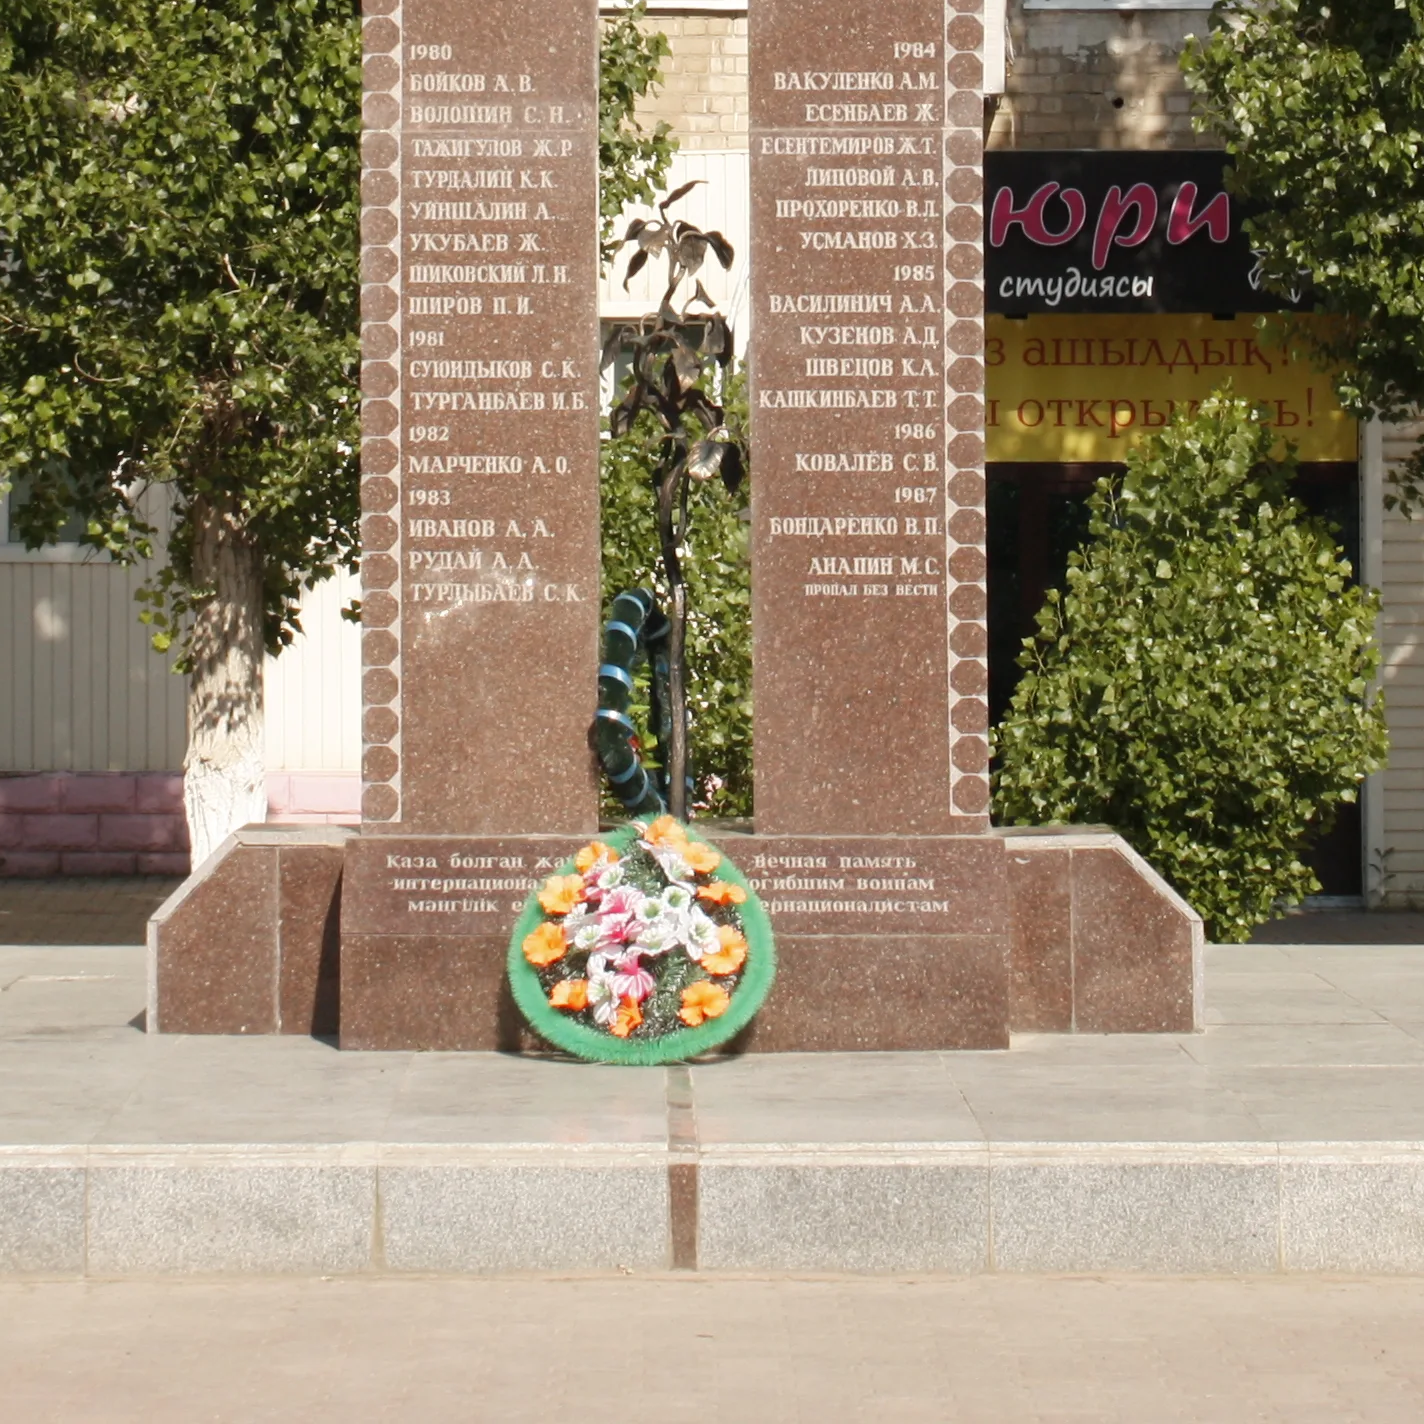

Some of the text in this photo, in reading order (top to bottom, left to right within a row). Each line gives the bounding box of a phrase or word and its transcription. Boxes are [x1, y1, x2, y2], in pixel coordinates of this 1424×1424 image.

[410, 45, 452, 60] 1980
[894, 42, 935, 58] 1984
[410, 72, 485, 92] БОЙКОВ
[774, 72, 894, 90] ВАКУЛЕНКО
[410, 106, 512, 123] ВОЛОШИН
[805, 104, 908, 122] ЕСЕНБАЕВ
[411, 139, 522, 157] ТАЖИГУЛОВ
[761, 137, 894, 155] ЕСЕНТЕМИРОВ
[805, 165, 895, 186] ЛИПОВОЙ
[776, 199, 899, 218] ПРОХОРЕНКО
[989, 181, 1229, 270] юри
[410, 233, 509, 252] УКУБАЕВ
[800, 232, 897, 249] УСМАНОВ
[409, 261, 525, 283] ШИКОВСКИЙ
[894, 265, 935, 281] 1985
[999, 267, 1153, 306] студиясы
[409, 297, 482, 315] ШИРОВ
[770, 295, 892, 313] ВАСИЛИНИЧ
[409, 331, 444, 347] 1981
[800, 326, 894, 344] КУЗЕНОВ
[805, 358, 893, 379] ШВЕЦОВ
[410, 392, 544, 410] ТУРГАНБАЕВ
[759, 390, 897, 408] КАШКИНБАЕВ
[409, 426, 449, 442] 1982
[895, 424, 936, 440] 1986
[409, 456, 523, 474] МАРЧЕНКО
[796, 450, 893, 471] КОВАЛЁВ
[409, 490, 451, 506] 1983
[895, 487, 937, 503] 1987
[409, 520, 495, 538] ИВАНОВ
[770, 517, 898, 537] БОНДАРЕНКО
[409, 547, 482, 571] РУДАЙ
[808, 557, 893, 575] АНАПИН
[805, 584, 938, 596] ПРОПАЛ БЕЗ ВЕСТИ
[839, 856, 916, 869] память
[747, 875, 935, 891] огибшим воинам
